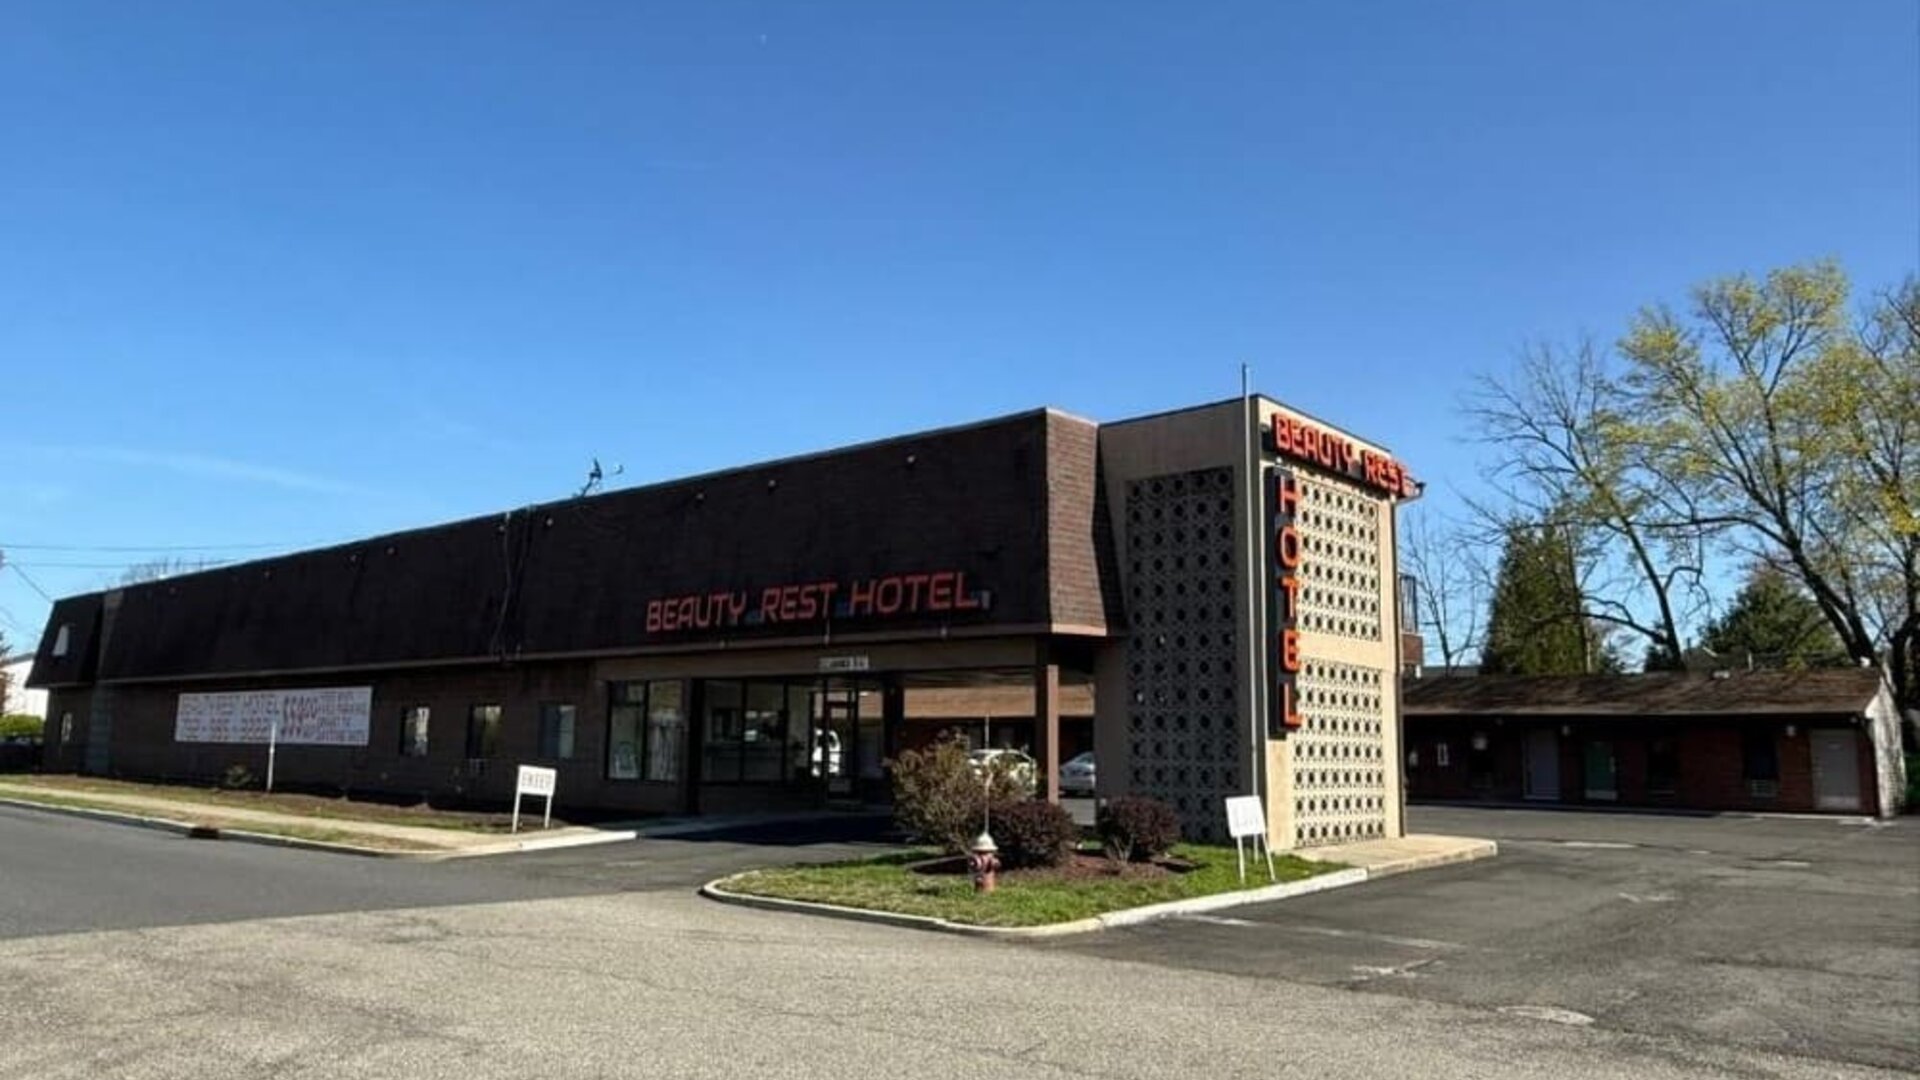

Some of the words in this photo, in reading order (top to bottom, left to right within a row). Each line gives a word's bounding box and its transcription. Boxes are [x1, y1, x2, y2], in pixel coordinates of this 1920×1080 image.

[1274, 413, 1354, 474] BEAUTY
[646, 593, 747, 632] BEAUTY
[760, 582, 837, 622] REST
[850, 571, 978, 615] HOTEL
[1278, 475, 1303, 729] HOTEL
